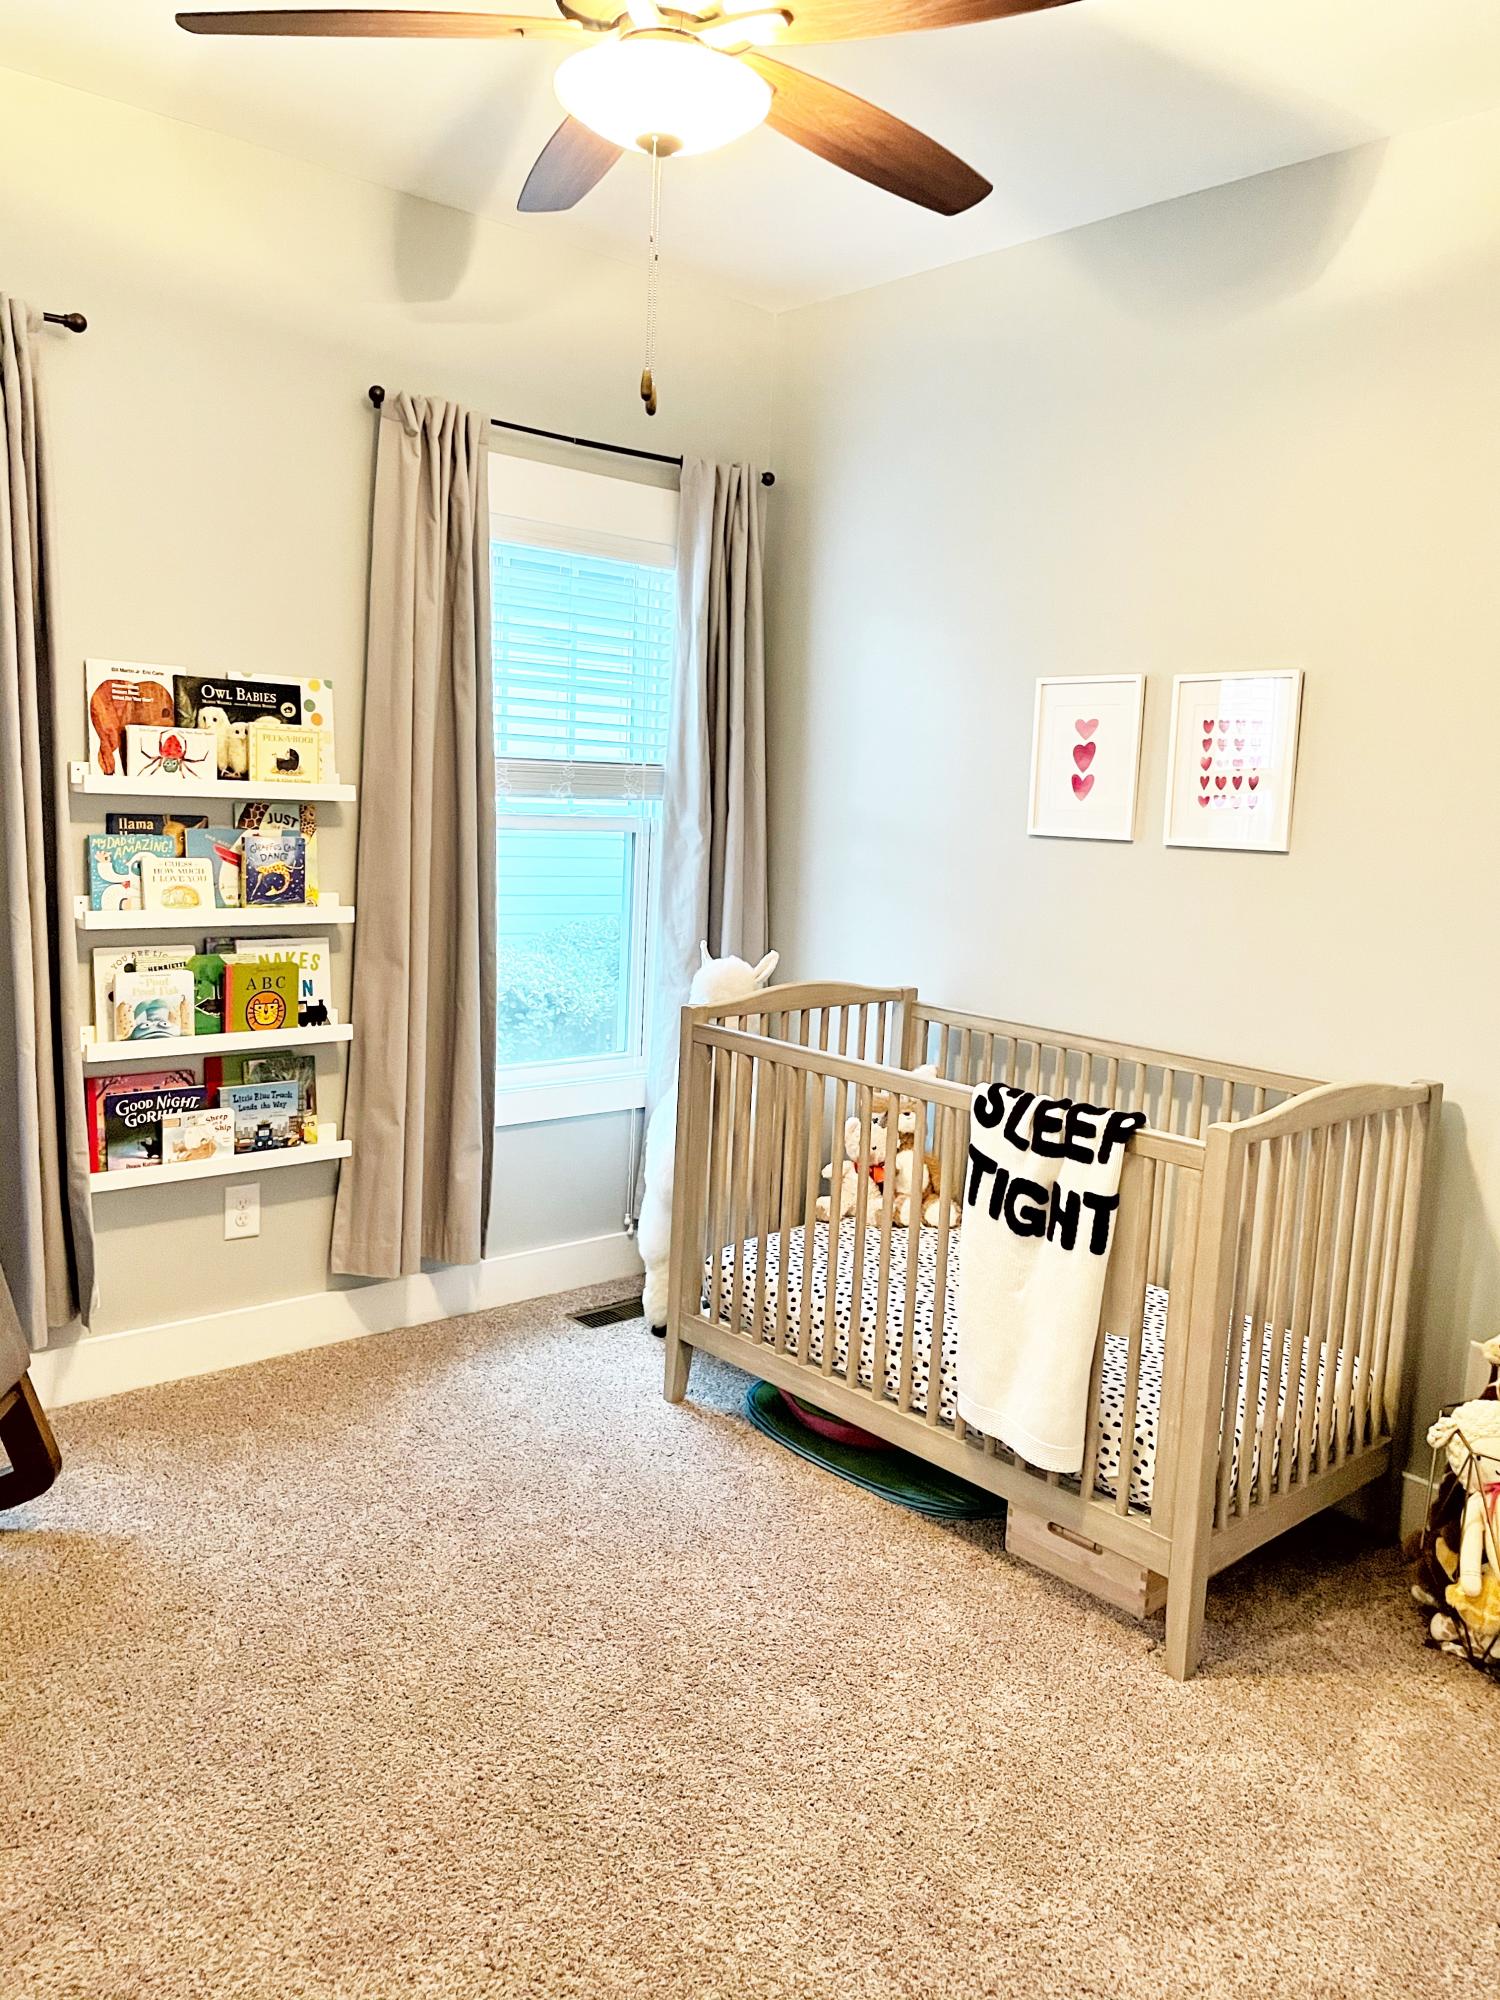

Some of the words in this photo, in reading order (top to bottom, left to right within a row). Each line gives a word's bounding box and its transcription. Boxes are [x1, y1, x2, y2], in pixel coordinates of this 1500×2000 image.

[119, 818, 154, 830] llama
[267, 812, 299, 828] JUST
[107, 836, 127, 848] DAD
[260, 853, 288, 862] DANCE
[186, 875, 207, 883] YOU
[131, 949, 150, 959] ARE
[974, 1082, 1146, 1164] SLEEP
[968, 1143, 1120, 1256] TIGHT
